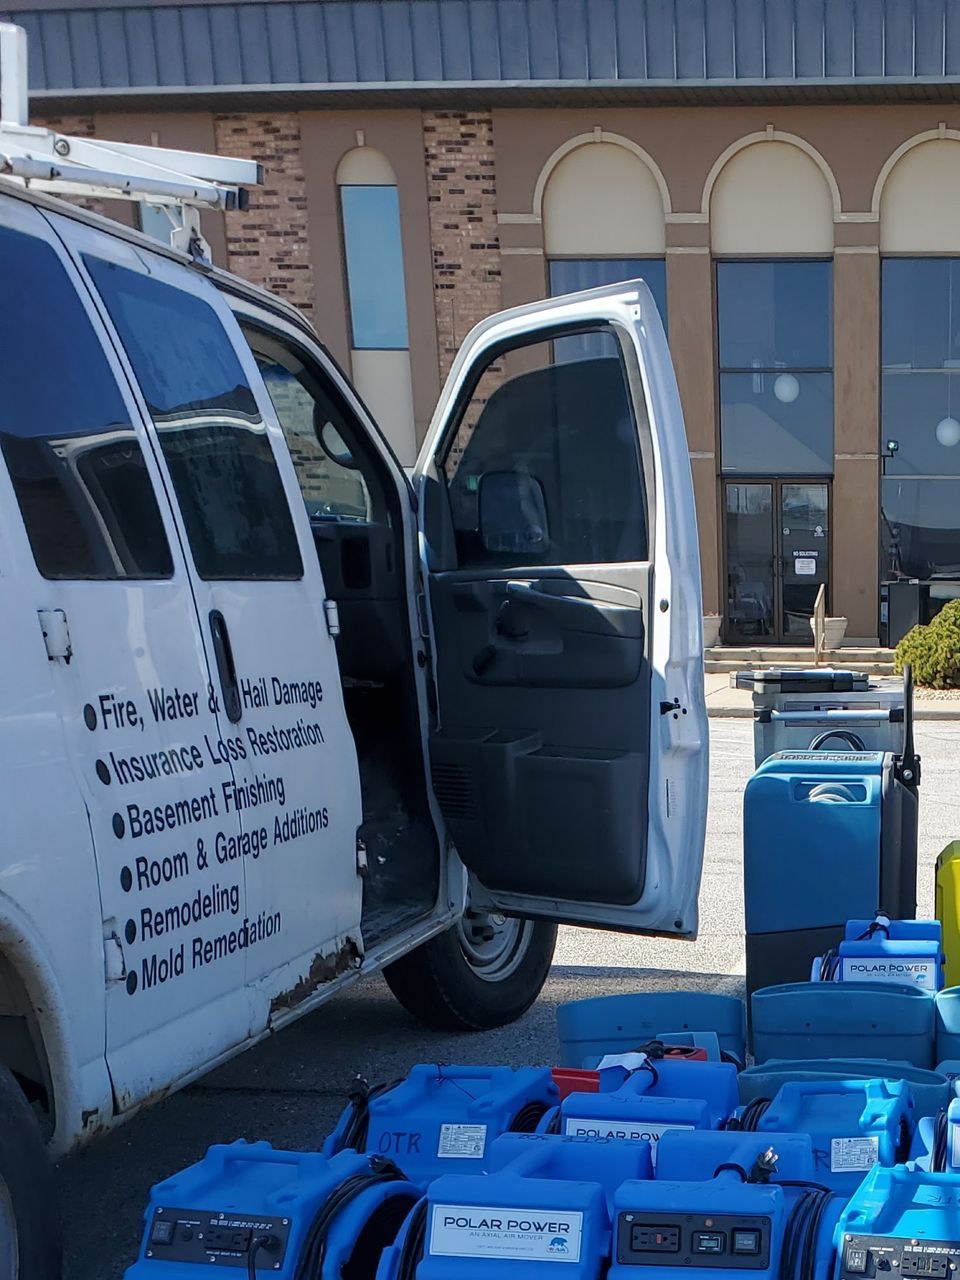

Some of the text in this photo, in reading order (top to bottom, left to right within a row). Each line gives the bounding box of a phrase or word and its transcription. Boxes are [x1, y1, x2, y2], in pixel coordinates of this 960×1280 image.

[99, 676, 324, 732] Fire, Water & Hail Damage
[109, 718, 325, 786] Insurance Loss Restoration
[127, 775, 286, 839] Basement Finishing
[135, 806, 329, 891] Room & Garage Additions
[140, 883, 240, 942] Remodeling
[141, 911, 282, 991] Mold Remediation
[889, 964, 928, 972] POWER
[378, 1131, 422, 1154] OTR
[576, 1128, 661, 1142] POLAR POW
[444, 1216, 571, 1234] POLAR POWER
